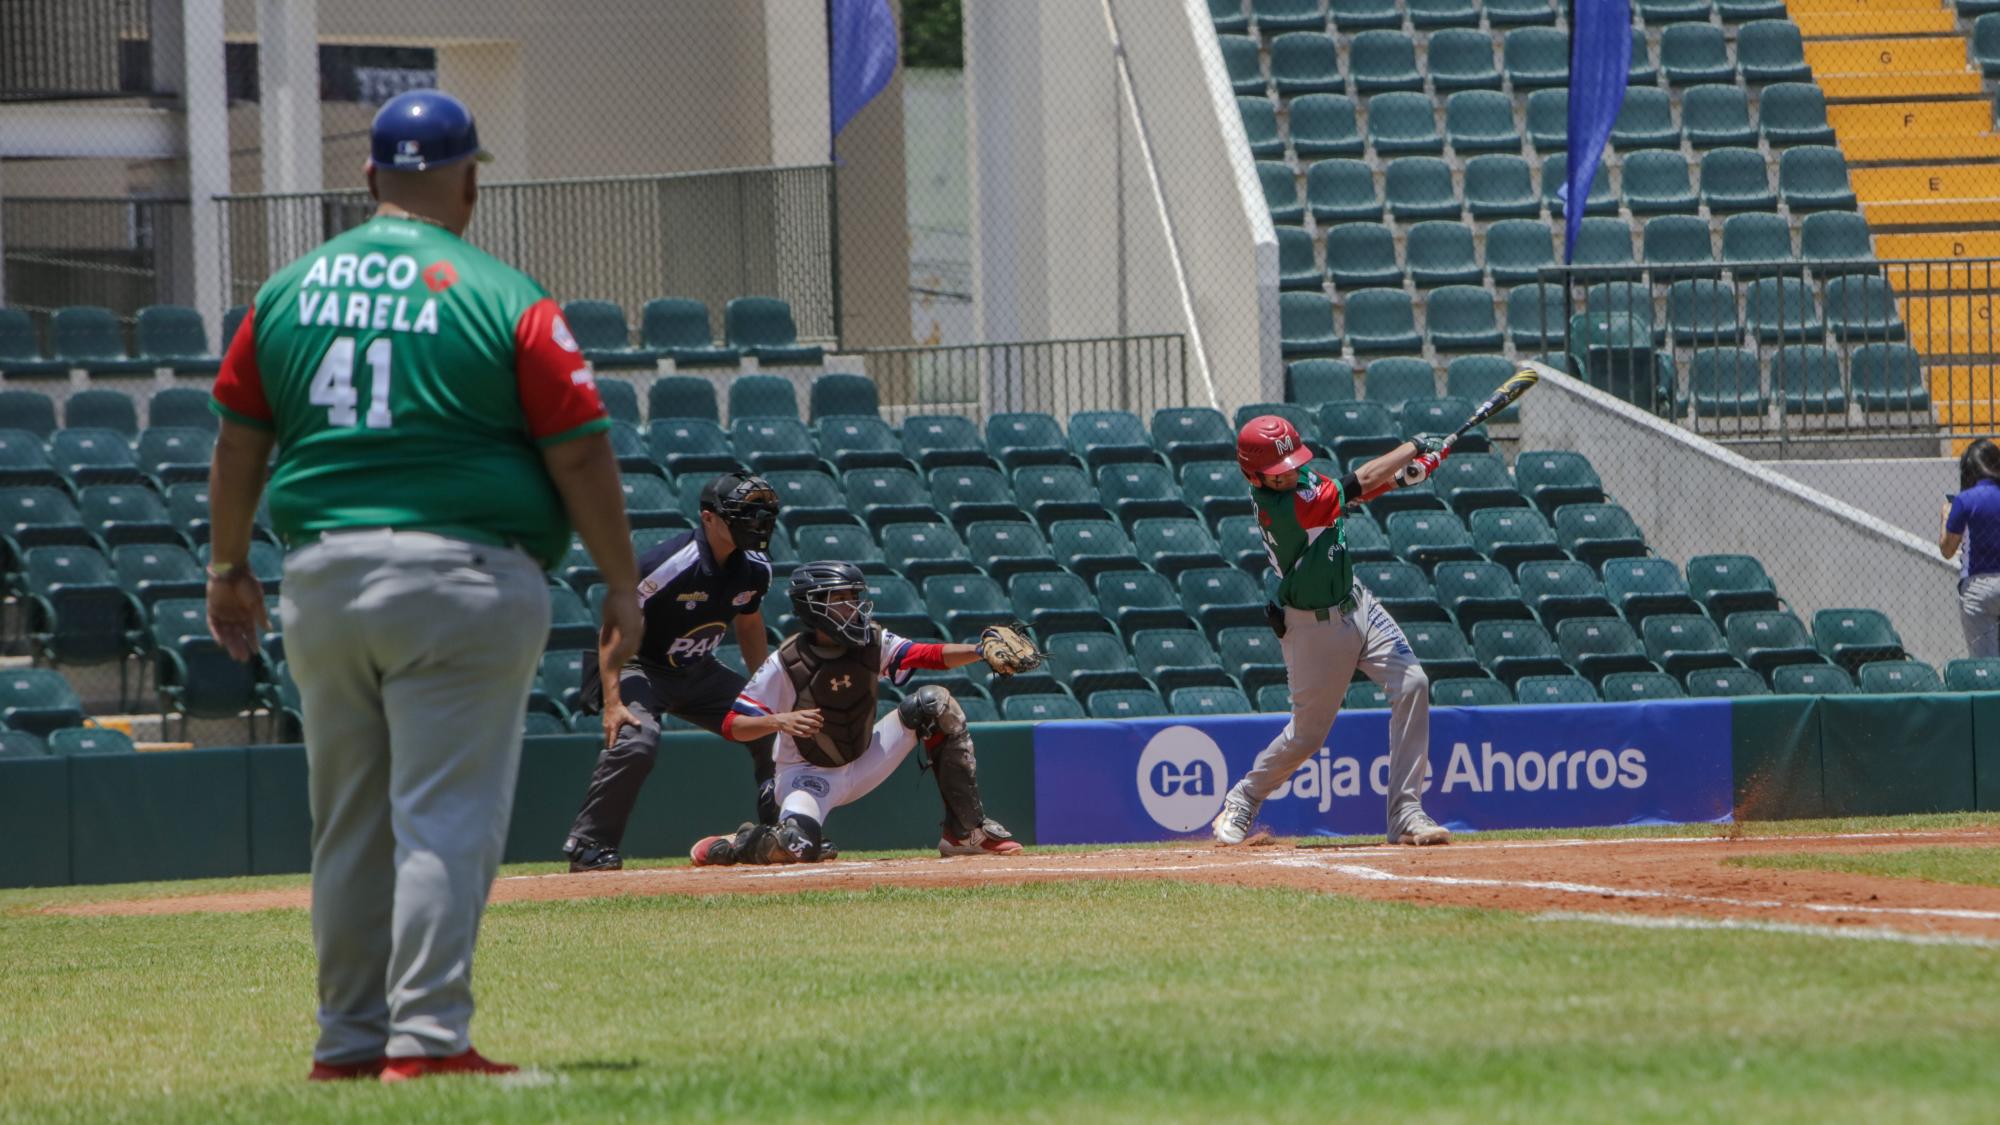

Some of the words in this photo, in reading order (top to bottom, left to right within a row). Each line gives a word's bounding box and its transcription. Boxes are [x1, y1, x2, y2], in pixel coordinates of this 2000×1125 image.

[1904, 113, 1915, 128] F
[1929, 177, 1940, 191] E
[1953, 242, 1965, 256] D
[302, 253, 418, 290] ARCO
[299, 291, 438, 334] VARELA
[309, 336, 392, 428] 41
[1274, 435, 1294, 455] M
[1441, 742, 1648, 792] Ahorros
